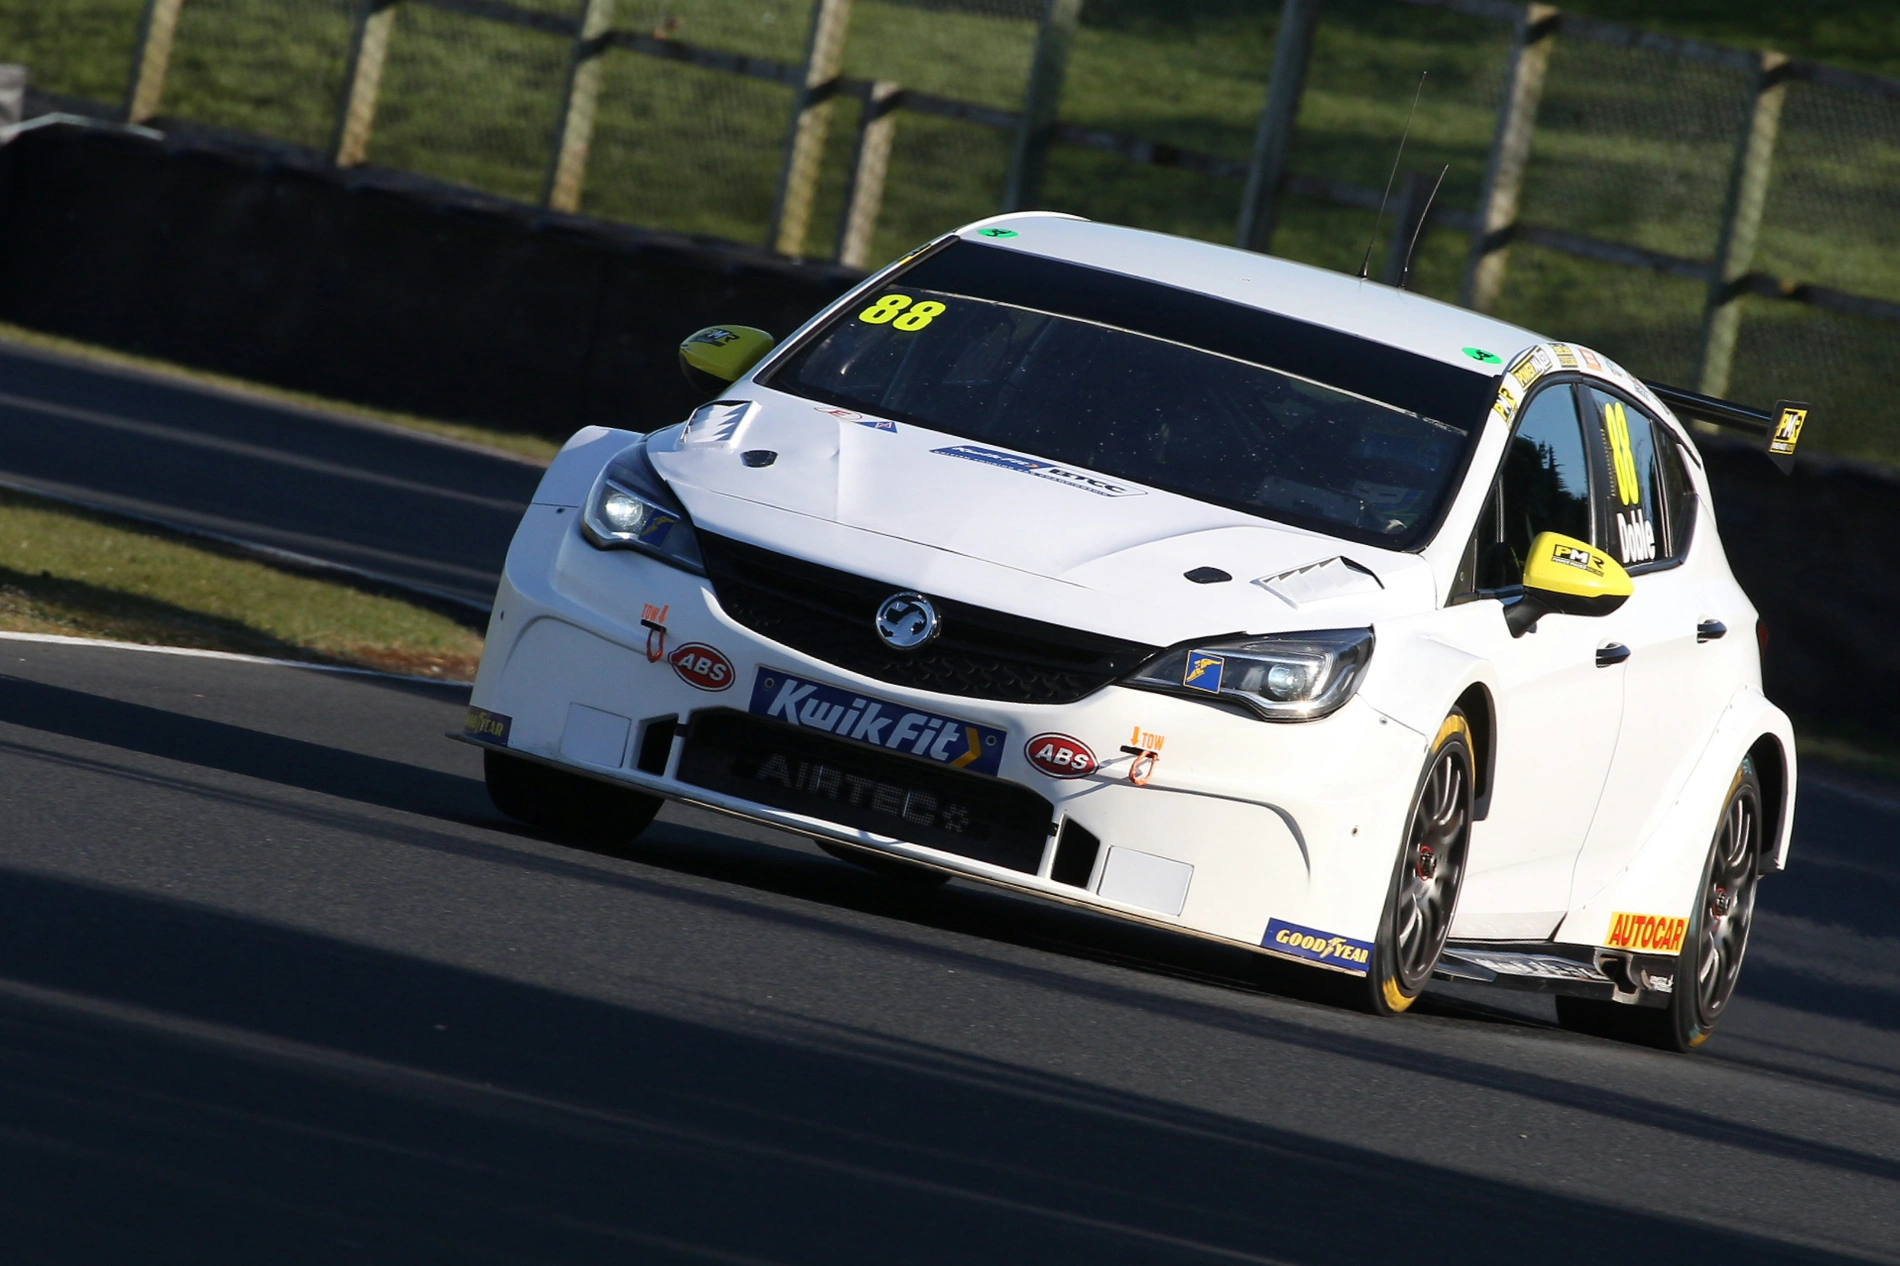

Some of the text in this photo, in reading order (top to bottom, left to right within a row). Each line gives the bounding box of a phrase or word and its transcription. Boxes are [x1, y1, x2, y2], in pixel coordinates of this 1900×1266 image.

[859, 294, 947, 331] 88
[1605, 402, 1639, 506] 88
[1617, 509, 1656, 564] Doble
[1555, 546, 1604, 570] PMR
[642, 603, 660, 622] TOW
[678, 653, 727, 681] ABS
[1035, 743, 1089, 770] ABS
[1142, 732, 1165, 751] TOW
[756, 753, 938, 827] AIRTEC
[1276, 929, 1369, 964] GOODYEAR
[1608, 914, 1685, 951] AUTOCAR
